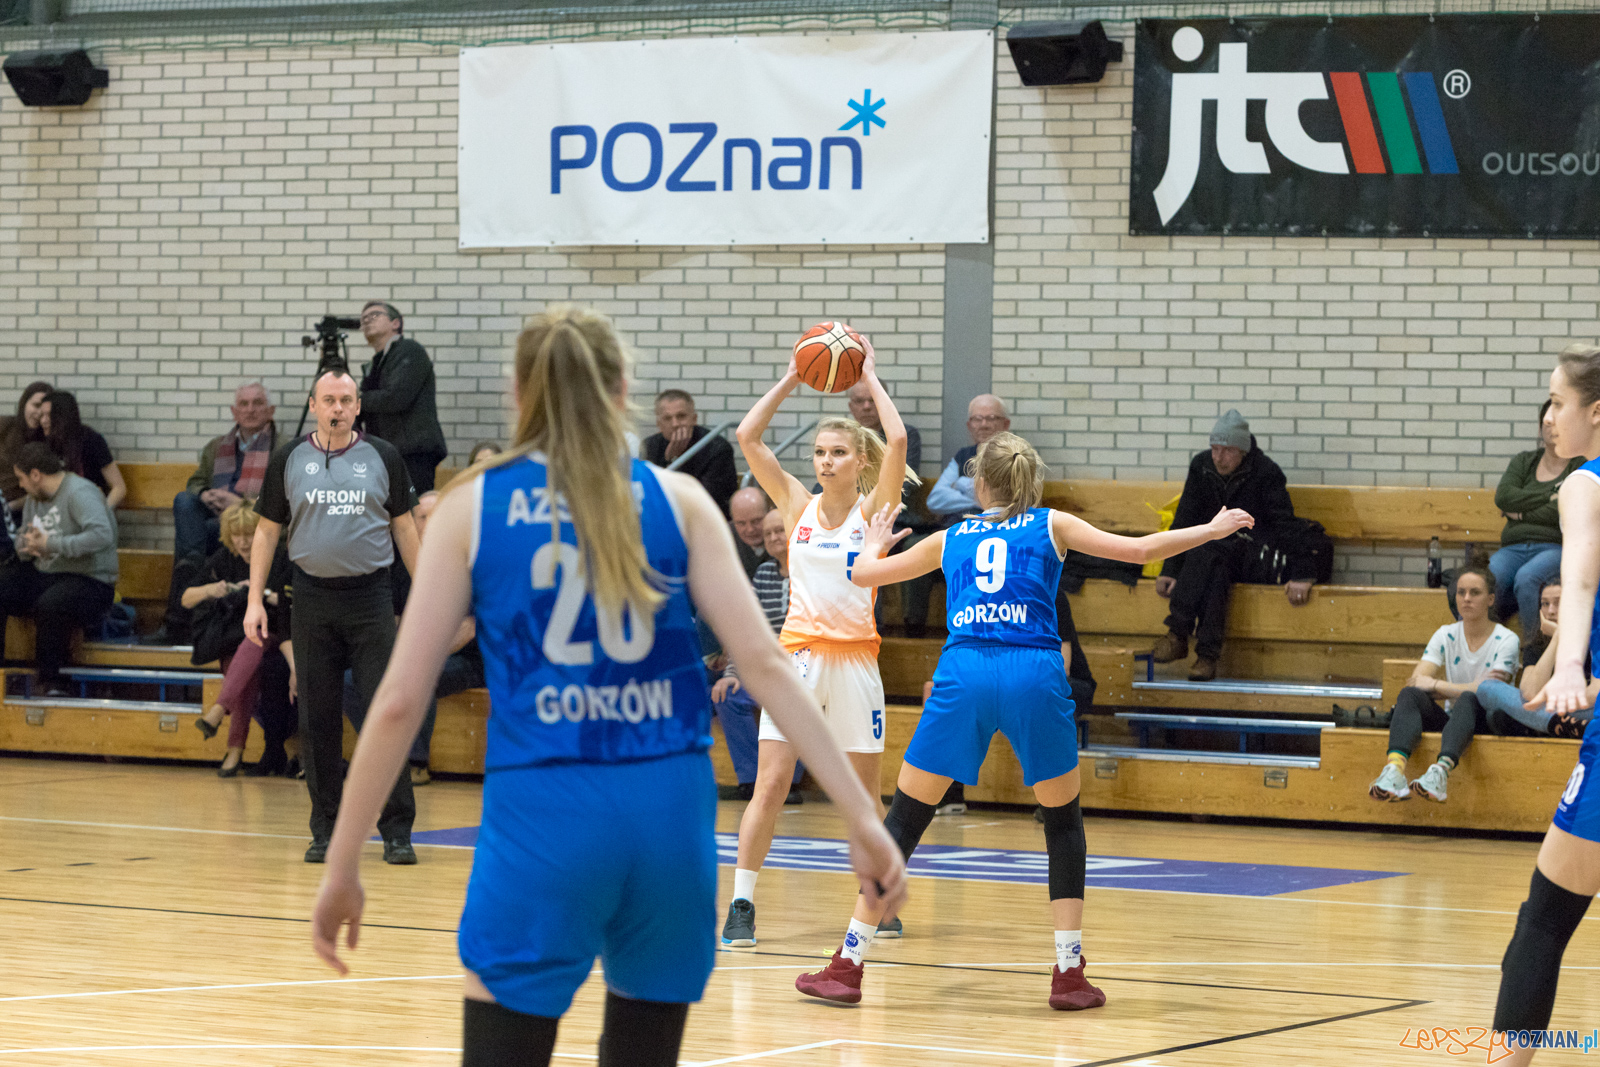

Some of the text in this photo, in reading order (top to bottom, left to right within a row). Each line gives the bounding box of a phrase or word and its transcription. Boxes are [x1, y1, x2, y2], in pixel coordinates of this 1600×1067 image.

[305, 488, 367, 504] VERONI
[327, 504, 366, 516] active
[954, 513, 1035, 536] AZS AJP
[975, 537, 1007, 594] 9
[530, 541, 656, 665] 20
[952, 601, 1028, 627] GORZÓW
[872, 710, 883, 740] 5
